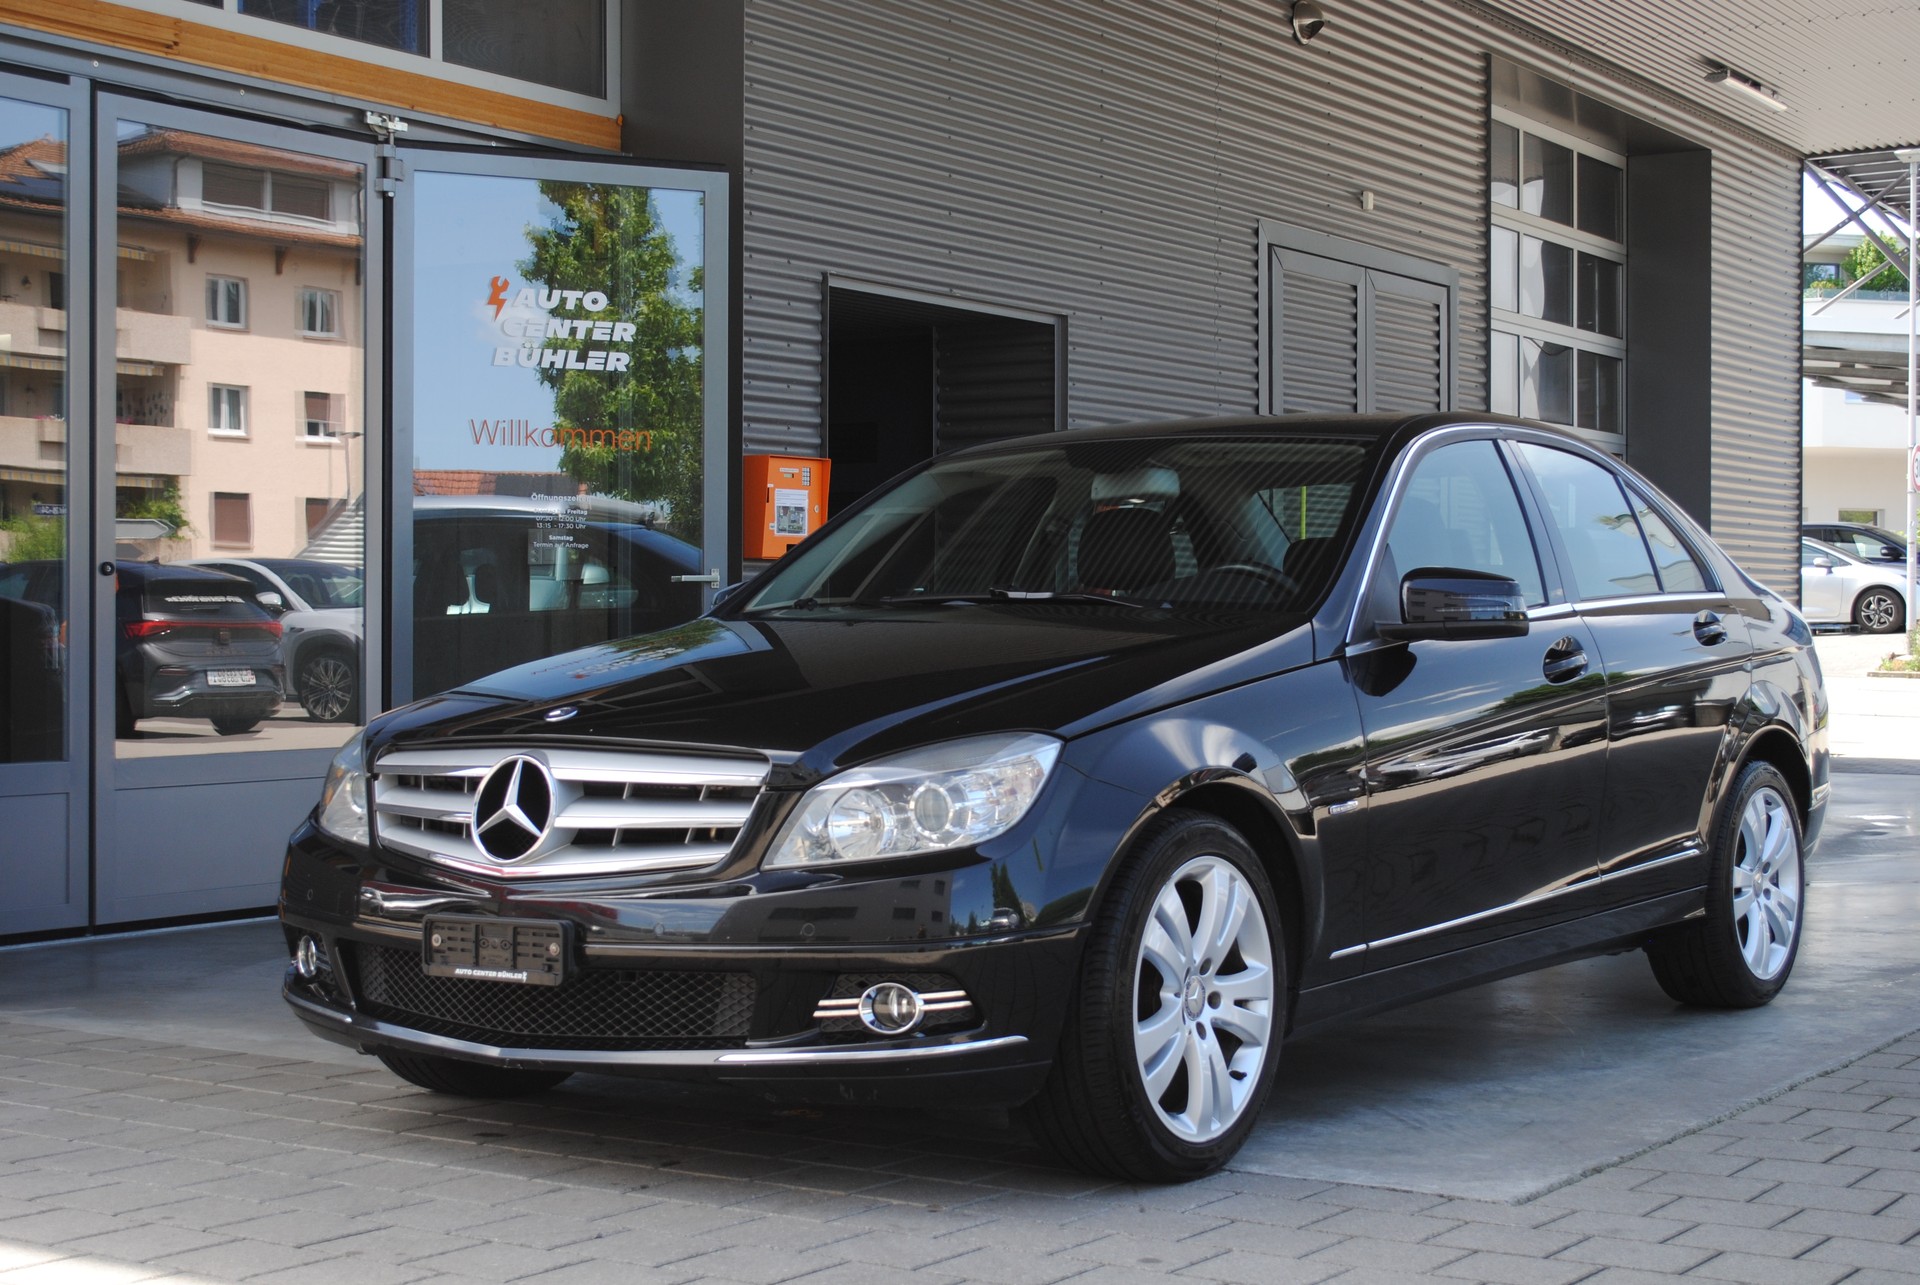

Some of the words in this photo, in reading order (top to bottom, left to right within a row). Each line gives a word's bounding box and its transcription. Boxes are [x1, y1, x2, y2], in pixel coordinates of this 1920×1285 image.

[511, 288, 608, 312] AUTO
[502, 317, 636, 342] CENTER
[493, 340, 631, 372] BÜHLER
[470, 418, 651, 451] Willkommen
[531, 492, 591, 502] Öffnungszeiten
[473, 969, 497, 977] CENTER
[498, 971, 523, 979] BÜHLER
